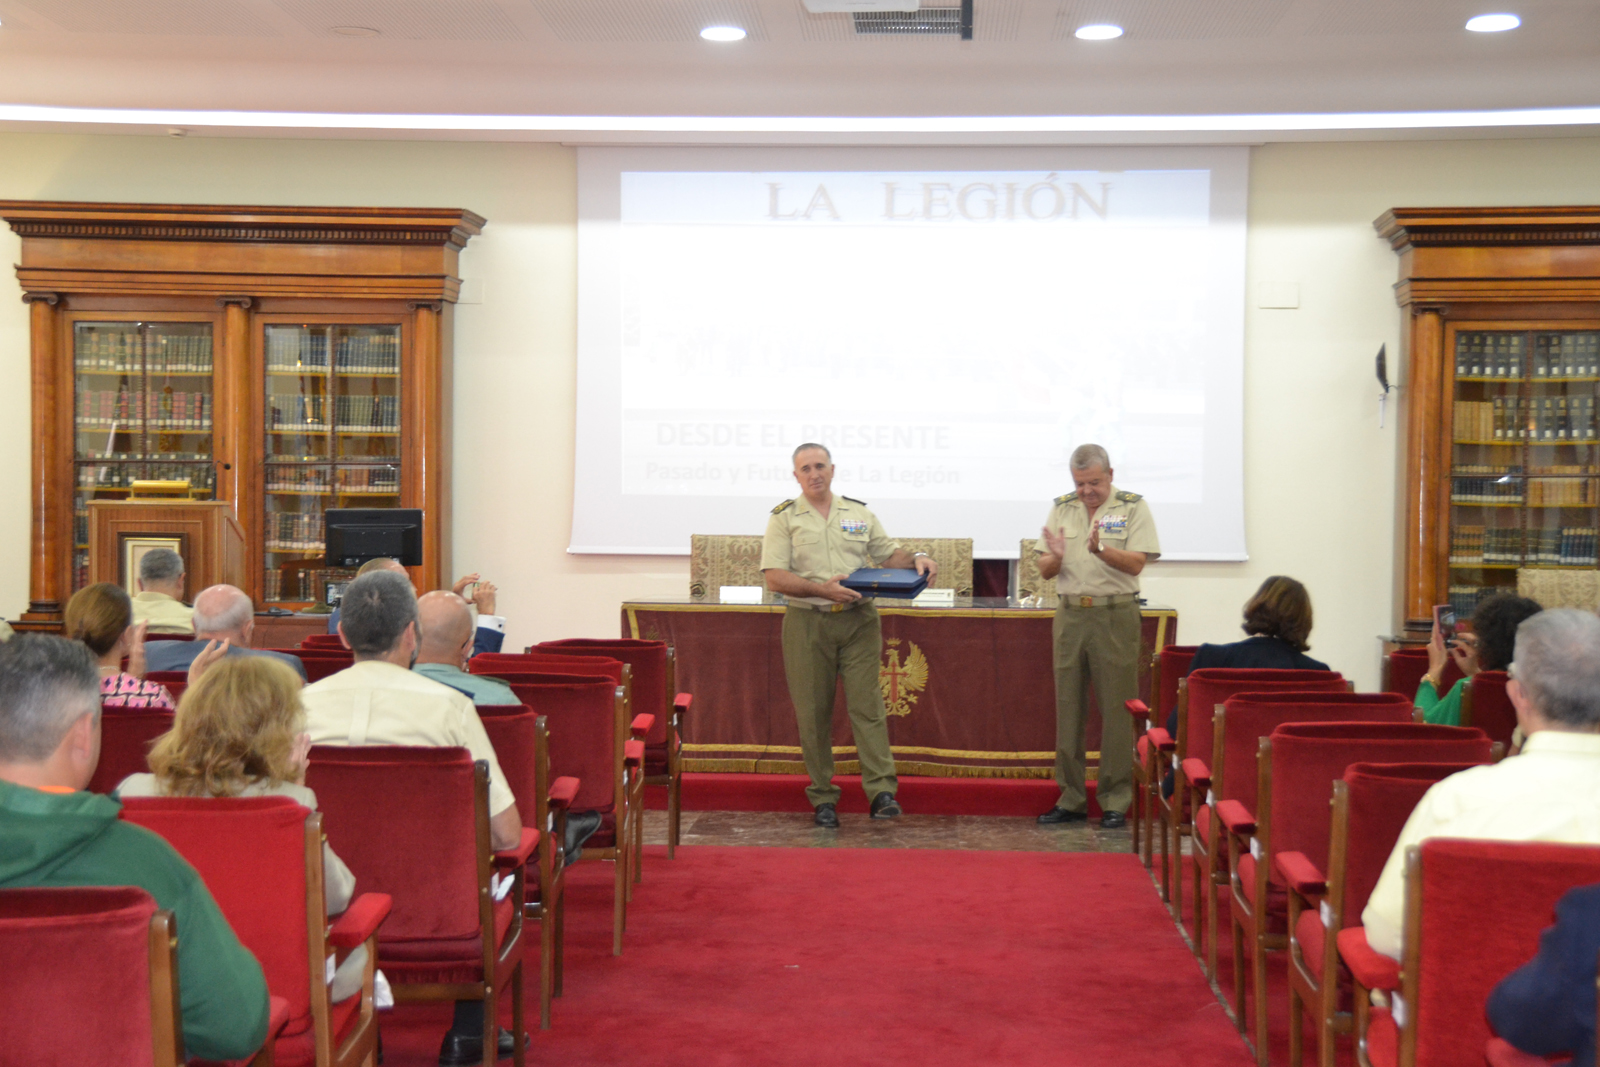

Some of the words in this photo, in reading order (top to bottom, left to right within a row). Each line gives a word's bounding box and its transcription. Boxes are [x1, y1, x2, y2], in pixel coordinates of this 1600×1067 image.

[765, 182, 842, 222] LA
[880, 172, 1114, 222] LEGIÓN
[656, 422, 751, 447] DESDE
[760, 423, 792, 448] EL
[801, 424, 950, 450] PRESENTE
[645, 462, 722, 481] Pasado
[728, 467, 740, 485] y
[747, 463, 793, 482] Futu
[859, 464, 881, 483] La
[889, 464, 961, 488] Legión
